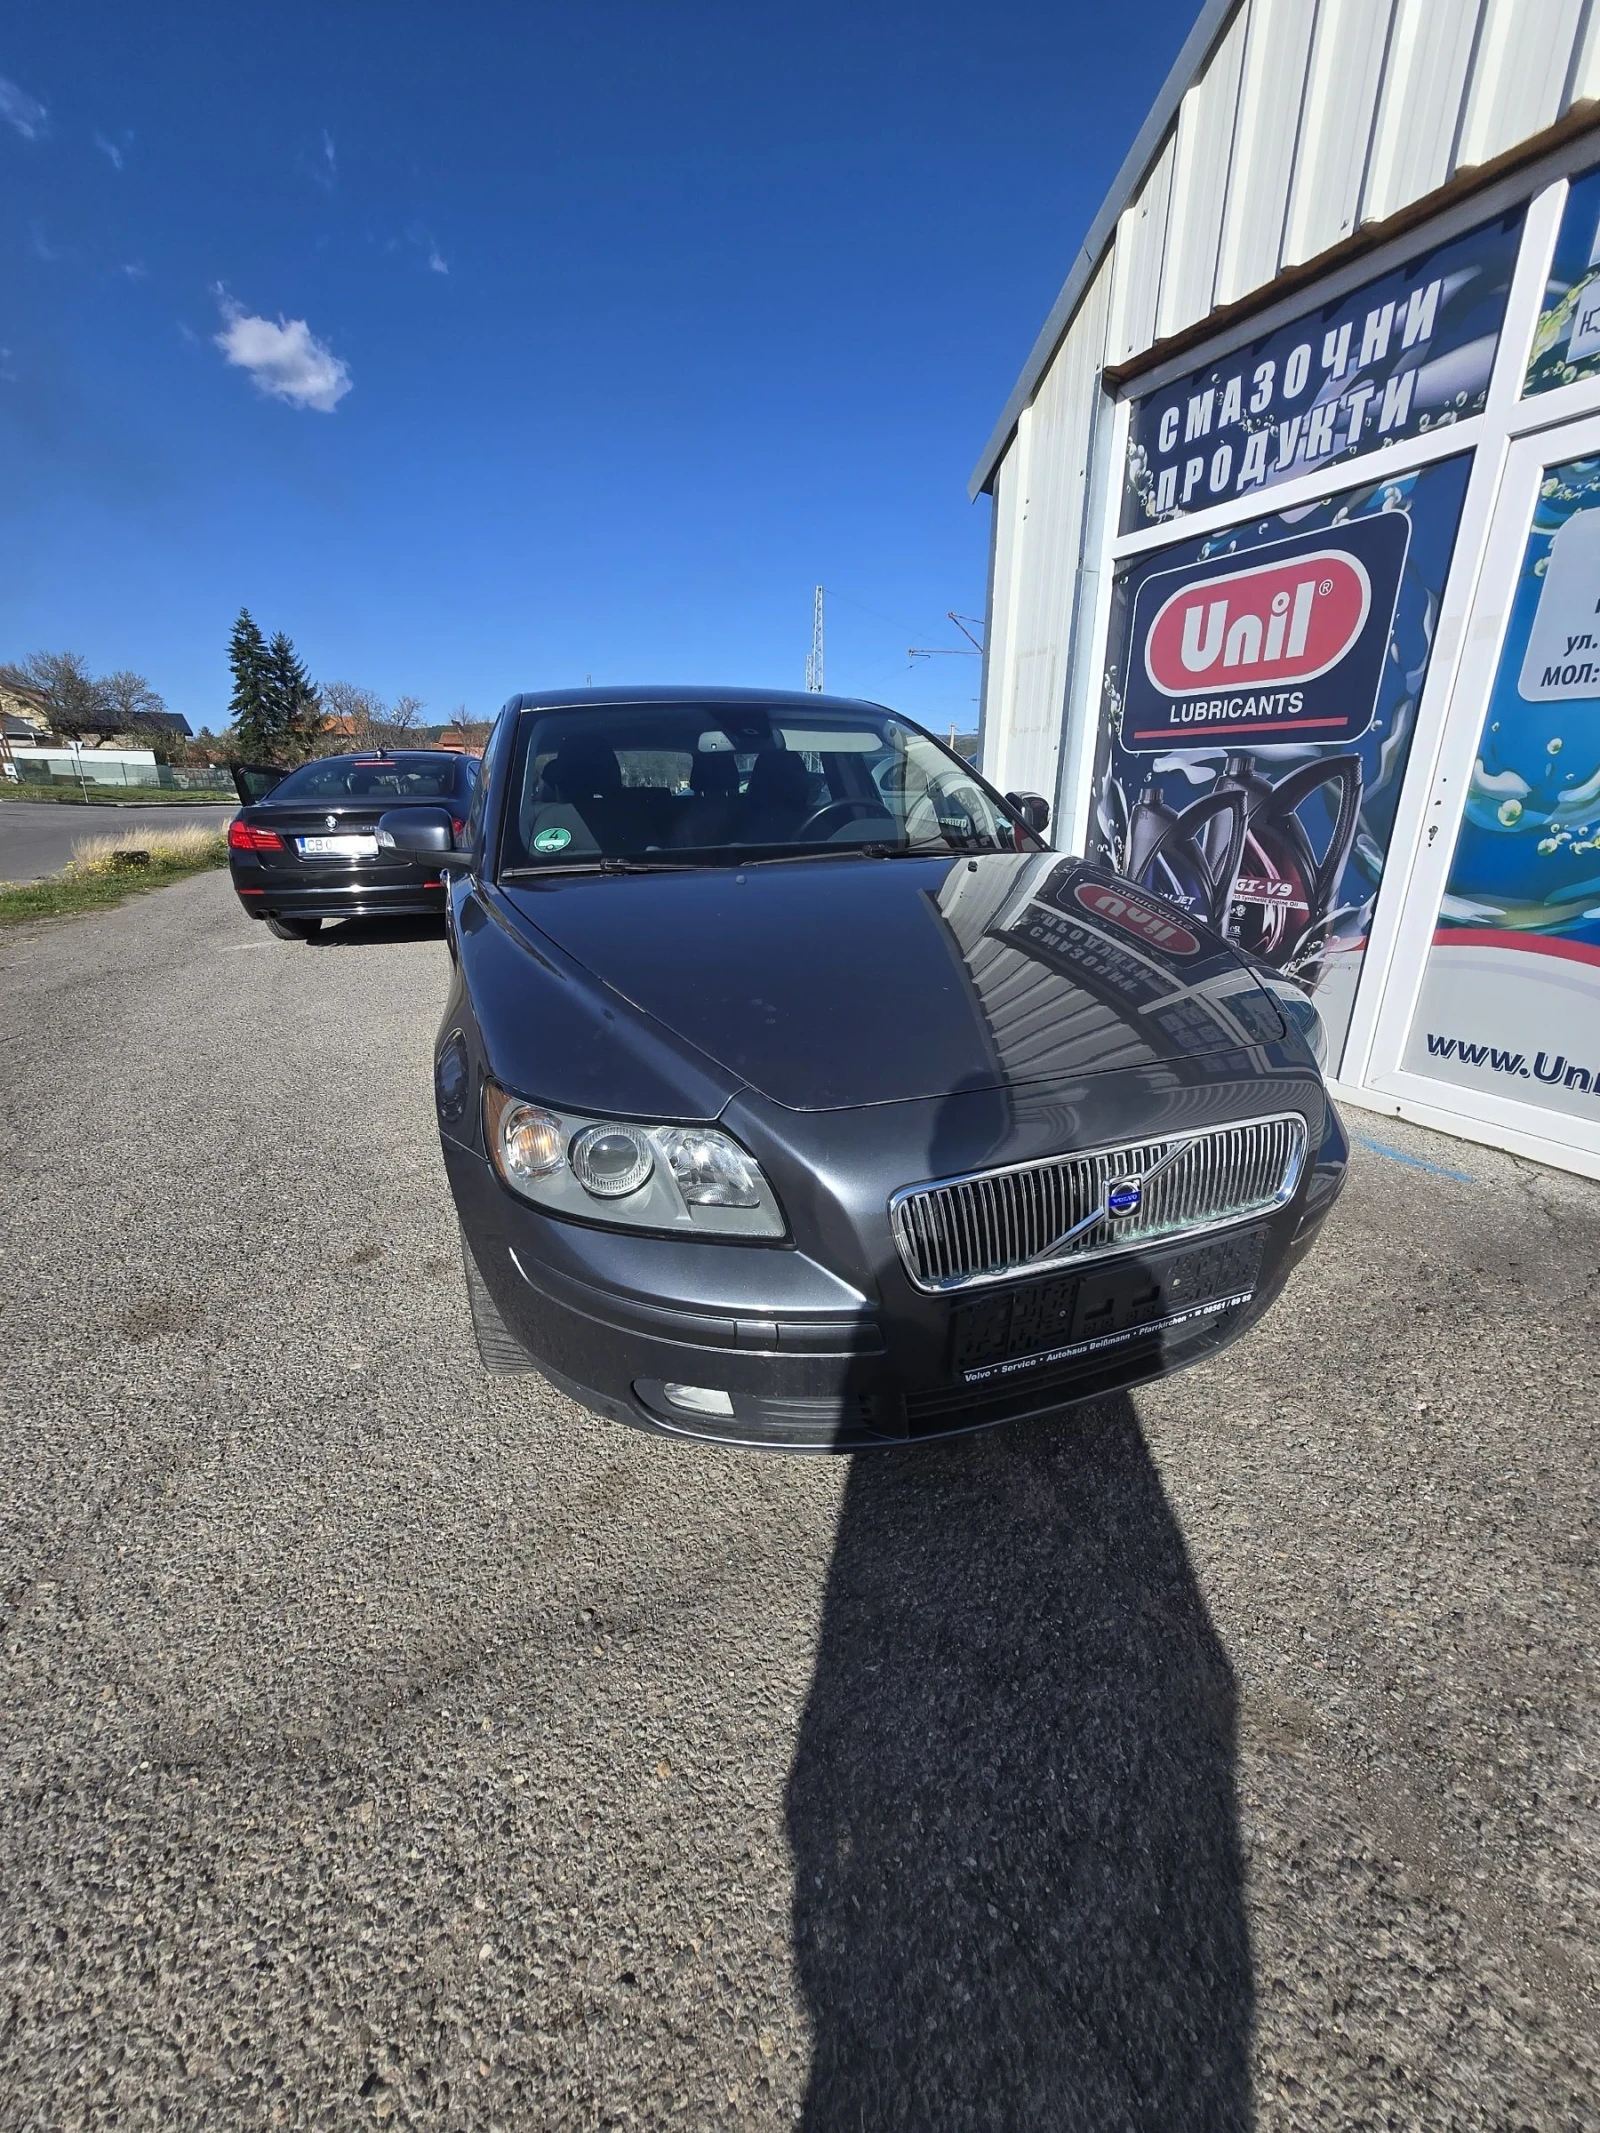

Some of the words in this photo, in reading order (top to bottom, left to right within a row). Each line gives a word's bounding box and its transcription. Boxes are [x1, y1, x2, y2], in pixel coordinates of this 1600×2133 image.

[1158, 278, 1444, 453] СМАЗОЧНИ
[1155, 369, 1420, 513] ПРОДУКТИ
[1180, 580, 1316, 673] Unil
[1563, 634, 1598, 657] ул.
[1540, 663, 1600, 687] МОЛ:
[1169, 691, 1304, 724] LUBRICANTS
[549, 829, 559, 840] 4
[1112, 1194, 1138, 1203] VOLVO
[964, 1369, 991, 1382] Volvo
[1001, 1358, 1036, 1373] Service
[1046, 1345, 1087, 1362] Autohaus
[1139, 1315, 1187, 1336] Pfarrkirchen
